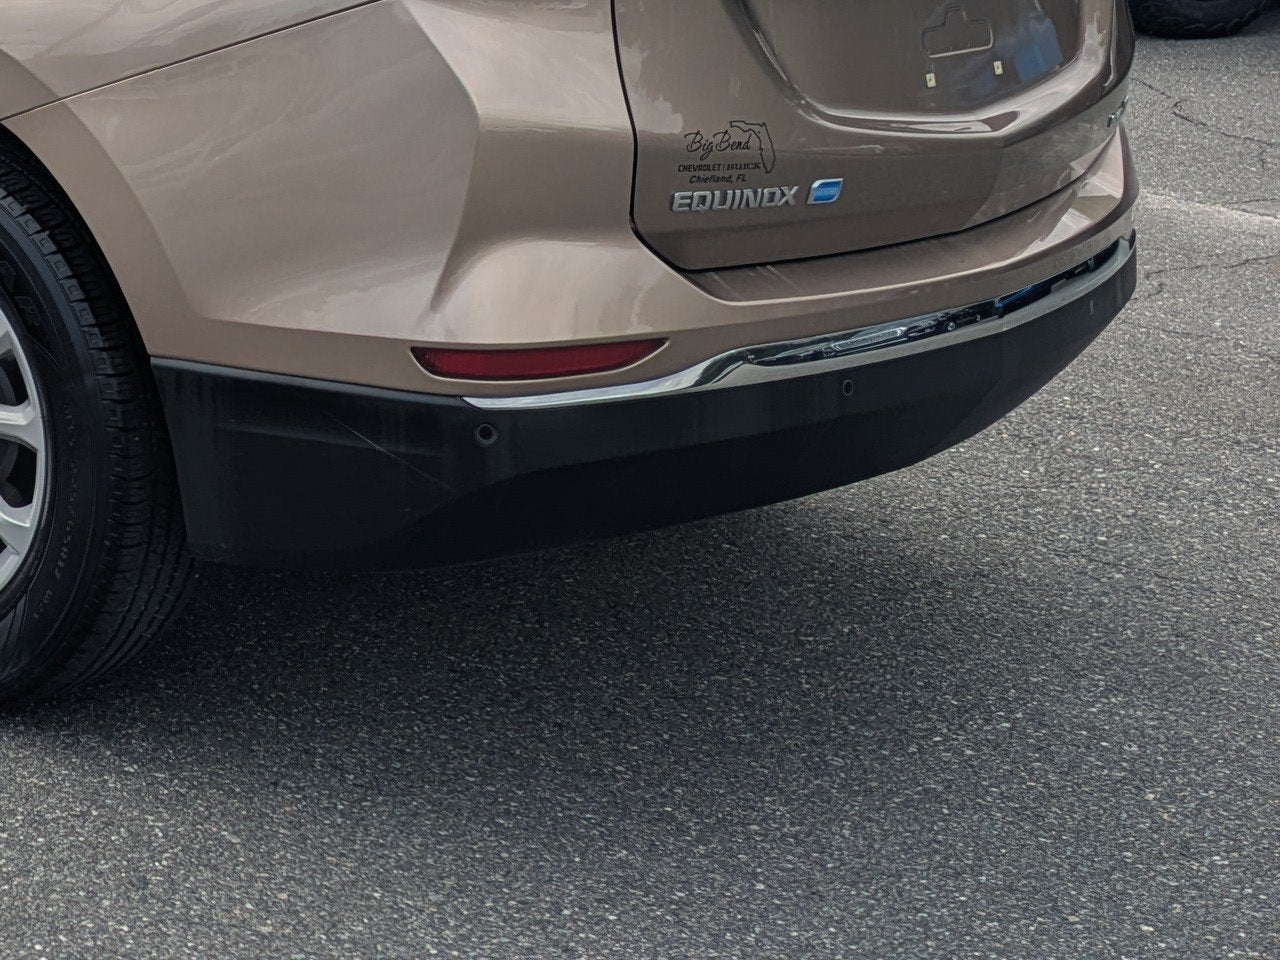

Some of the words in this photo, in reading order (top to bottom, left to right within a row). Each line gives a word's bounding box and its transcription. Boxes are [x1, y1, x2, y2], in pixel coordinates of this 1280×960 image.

[684, 130, 713, 161] Big
[713, 130, 752, 152] Bend
[678, 163, 722, 172] CHEVROLET
[726, 162, 761, 171] BUICK
[736, 173, 747, 182] FL
[670, 186, 800, 214] EQUINOX
